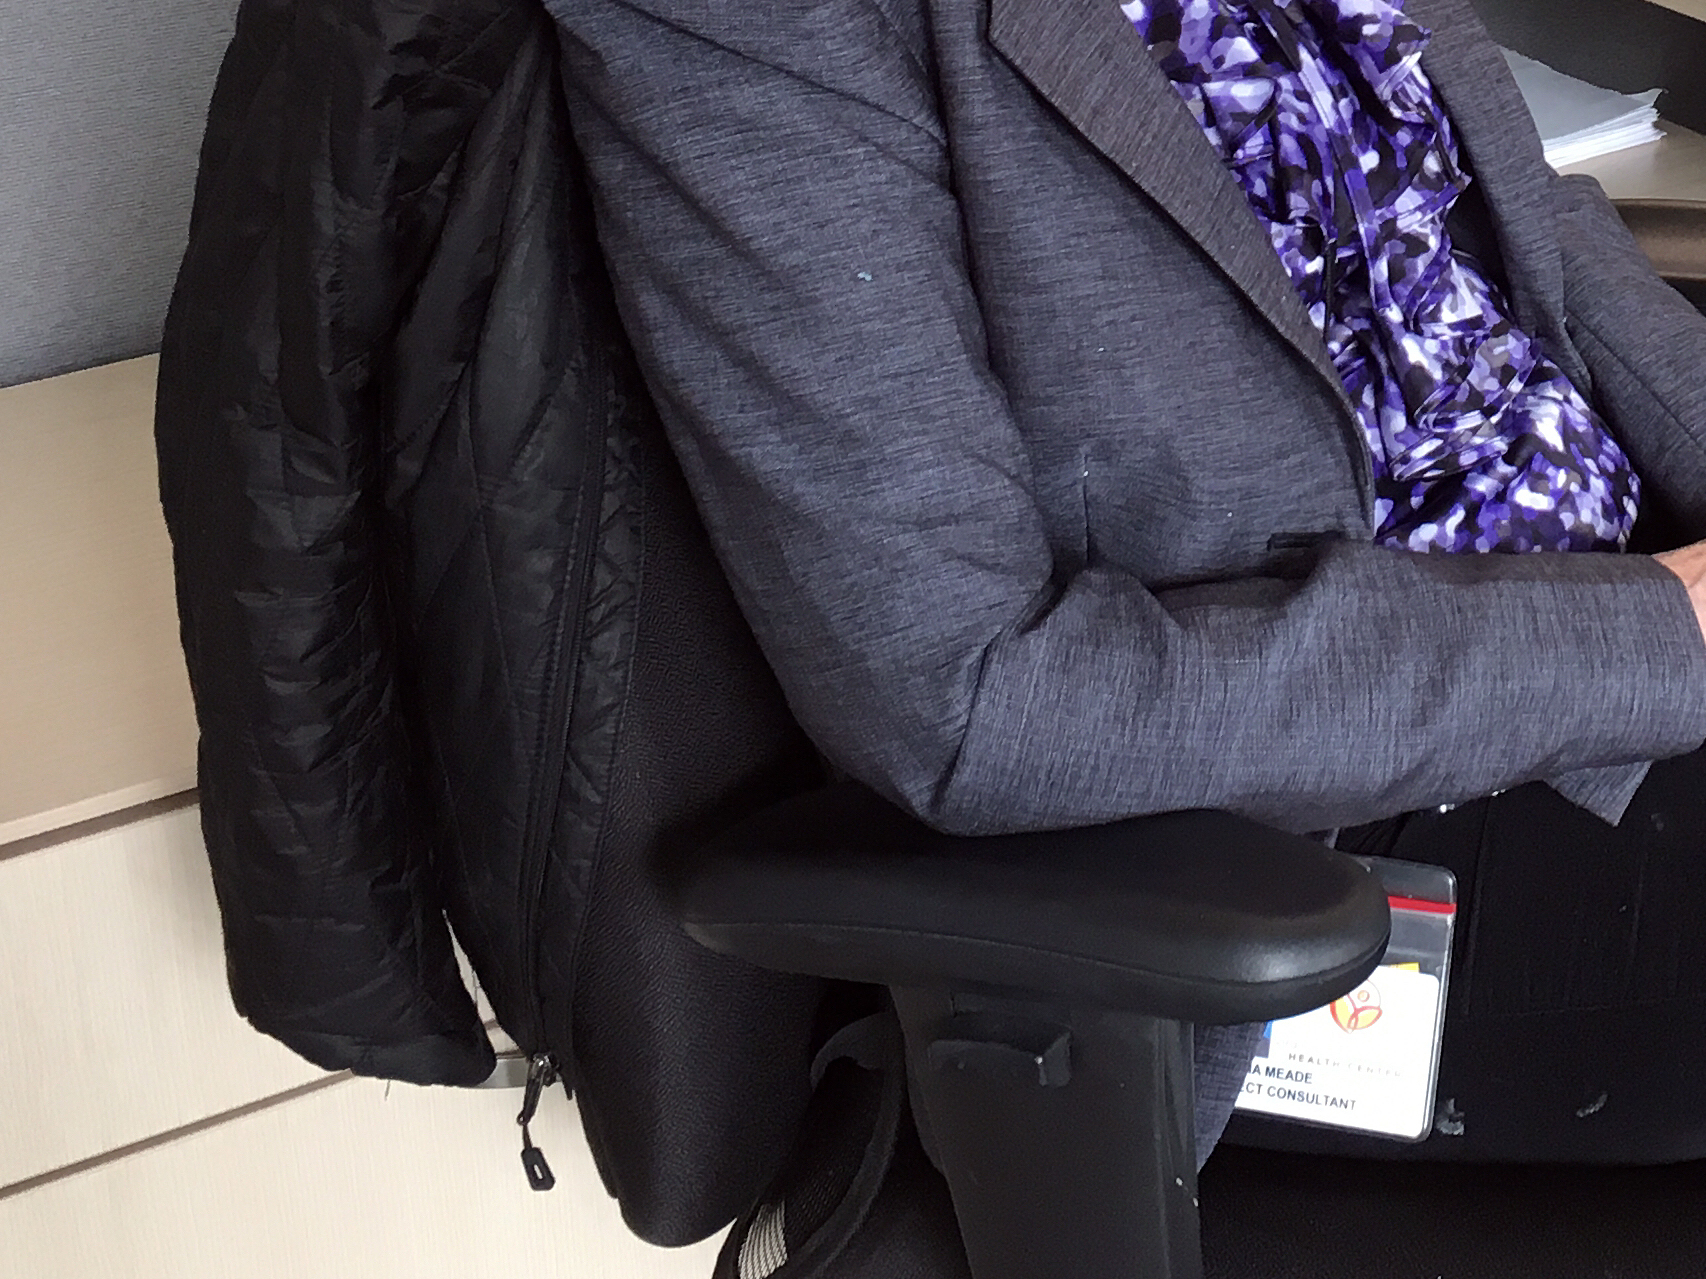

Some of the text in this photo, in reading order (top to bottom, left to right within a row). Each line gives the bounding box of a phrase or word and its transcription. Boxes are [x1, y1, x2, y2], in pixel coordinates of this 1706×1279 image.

[1289, 1053, 1340, 1067] HEALTH
[1265, 1066, 1312, 1084] MEADE
[1267, 1085, 1356, 1111] CONSULTANT
